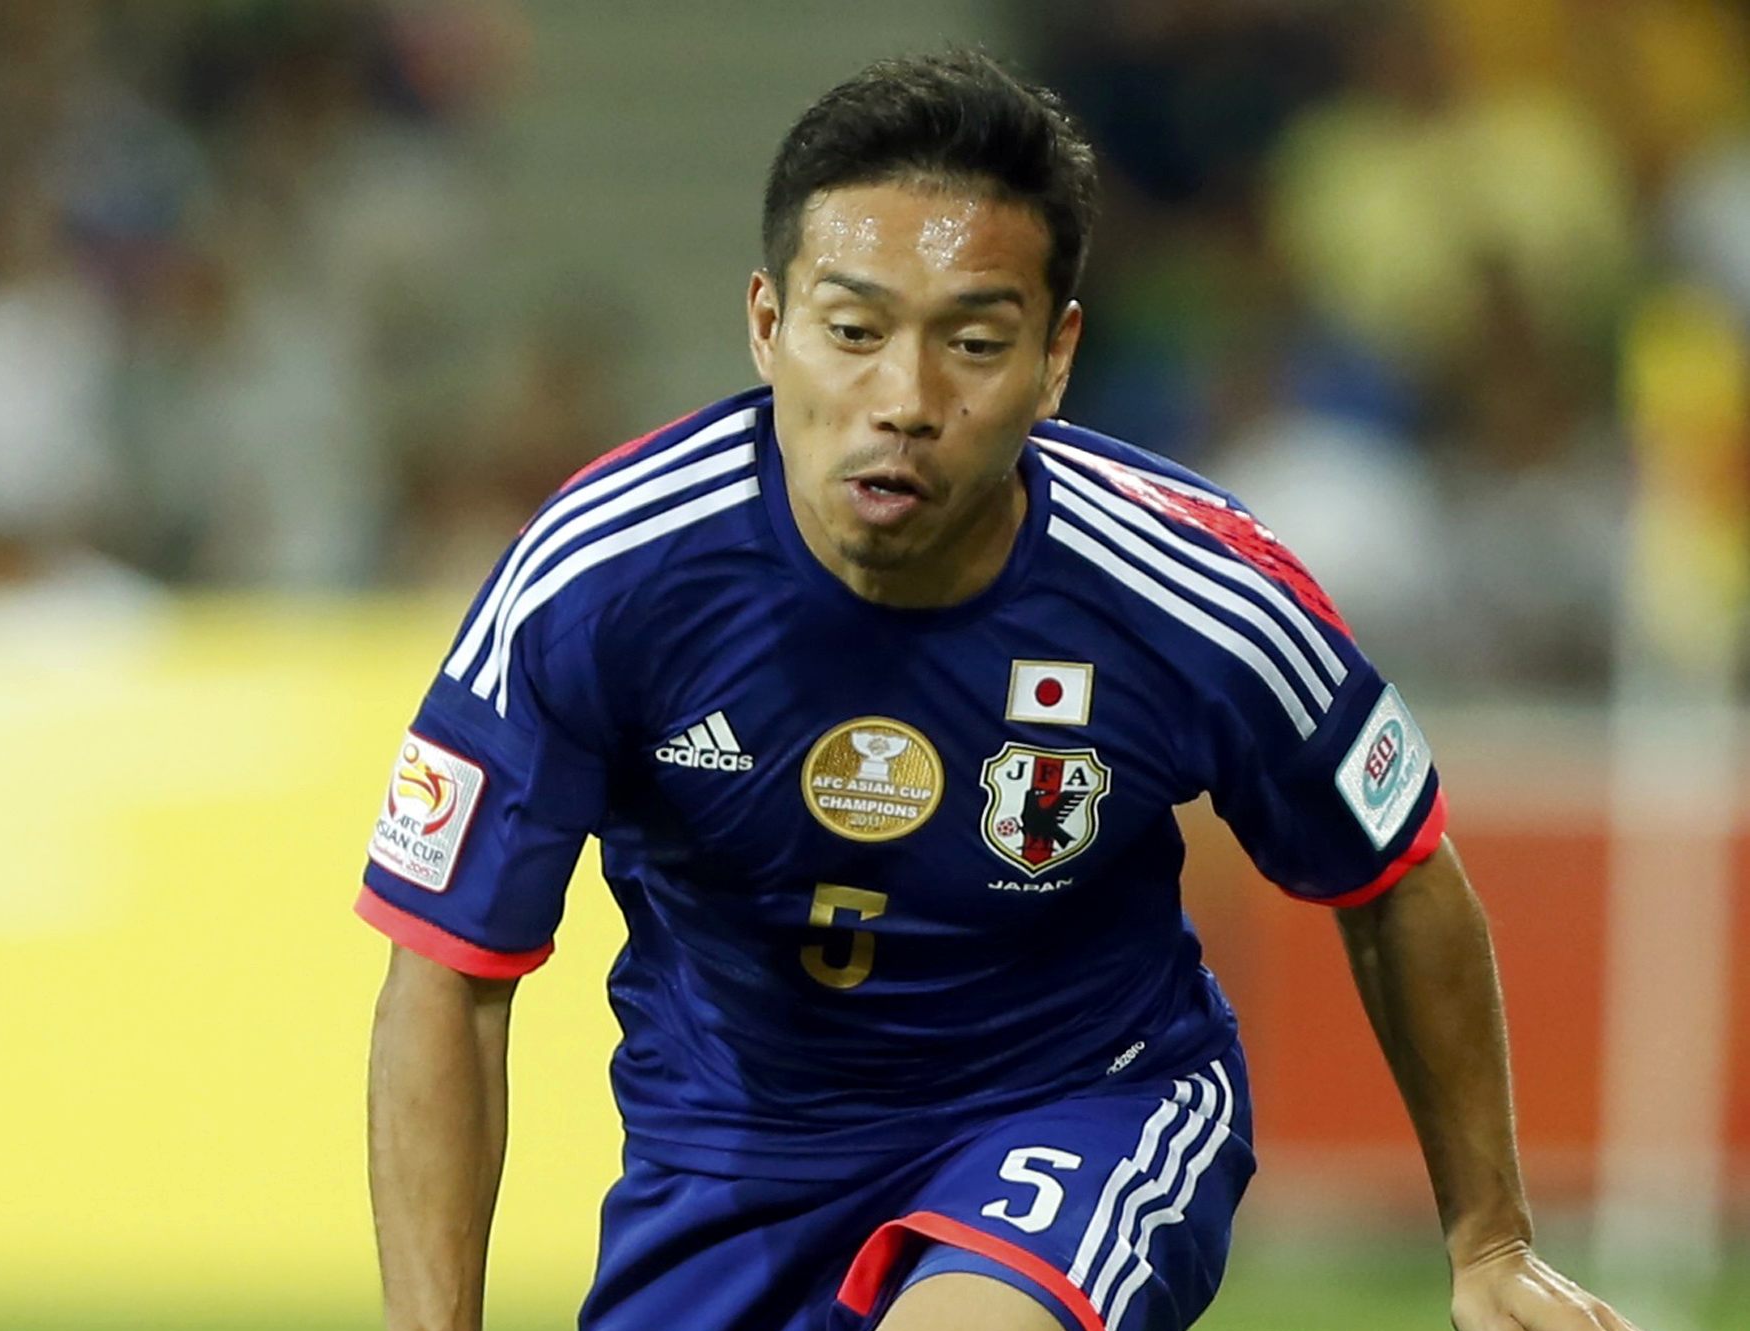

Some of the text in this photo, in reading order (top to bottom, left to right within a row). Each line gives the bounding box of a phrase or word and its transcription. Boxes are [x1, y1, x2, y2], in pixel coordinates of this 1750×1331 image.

[655, 746, 754, 772] adidas
[812, 776, 932, 801] AFC ASIAN CUP
[818, 796, 918, 819] CHAMPIONS
[412, 840, 443, 864] CUP
[988, 877, 1074, 893] JAPAN
[800, 882, 888, 989] 5
